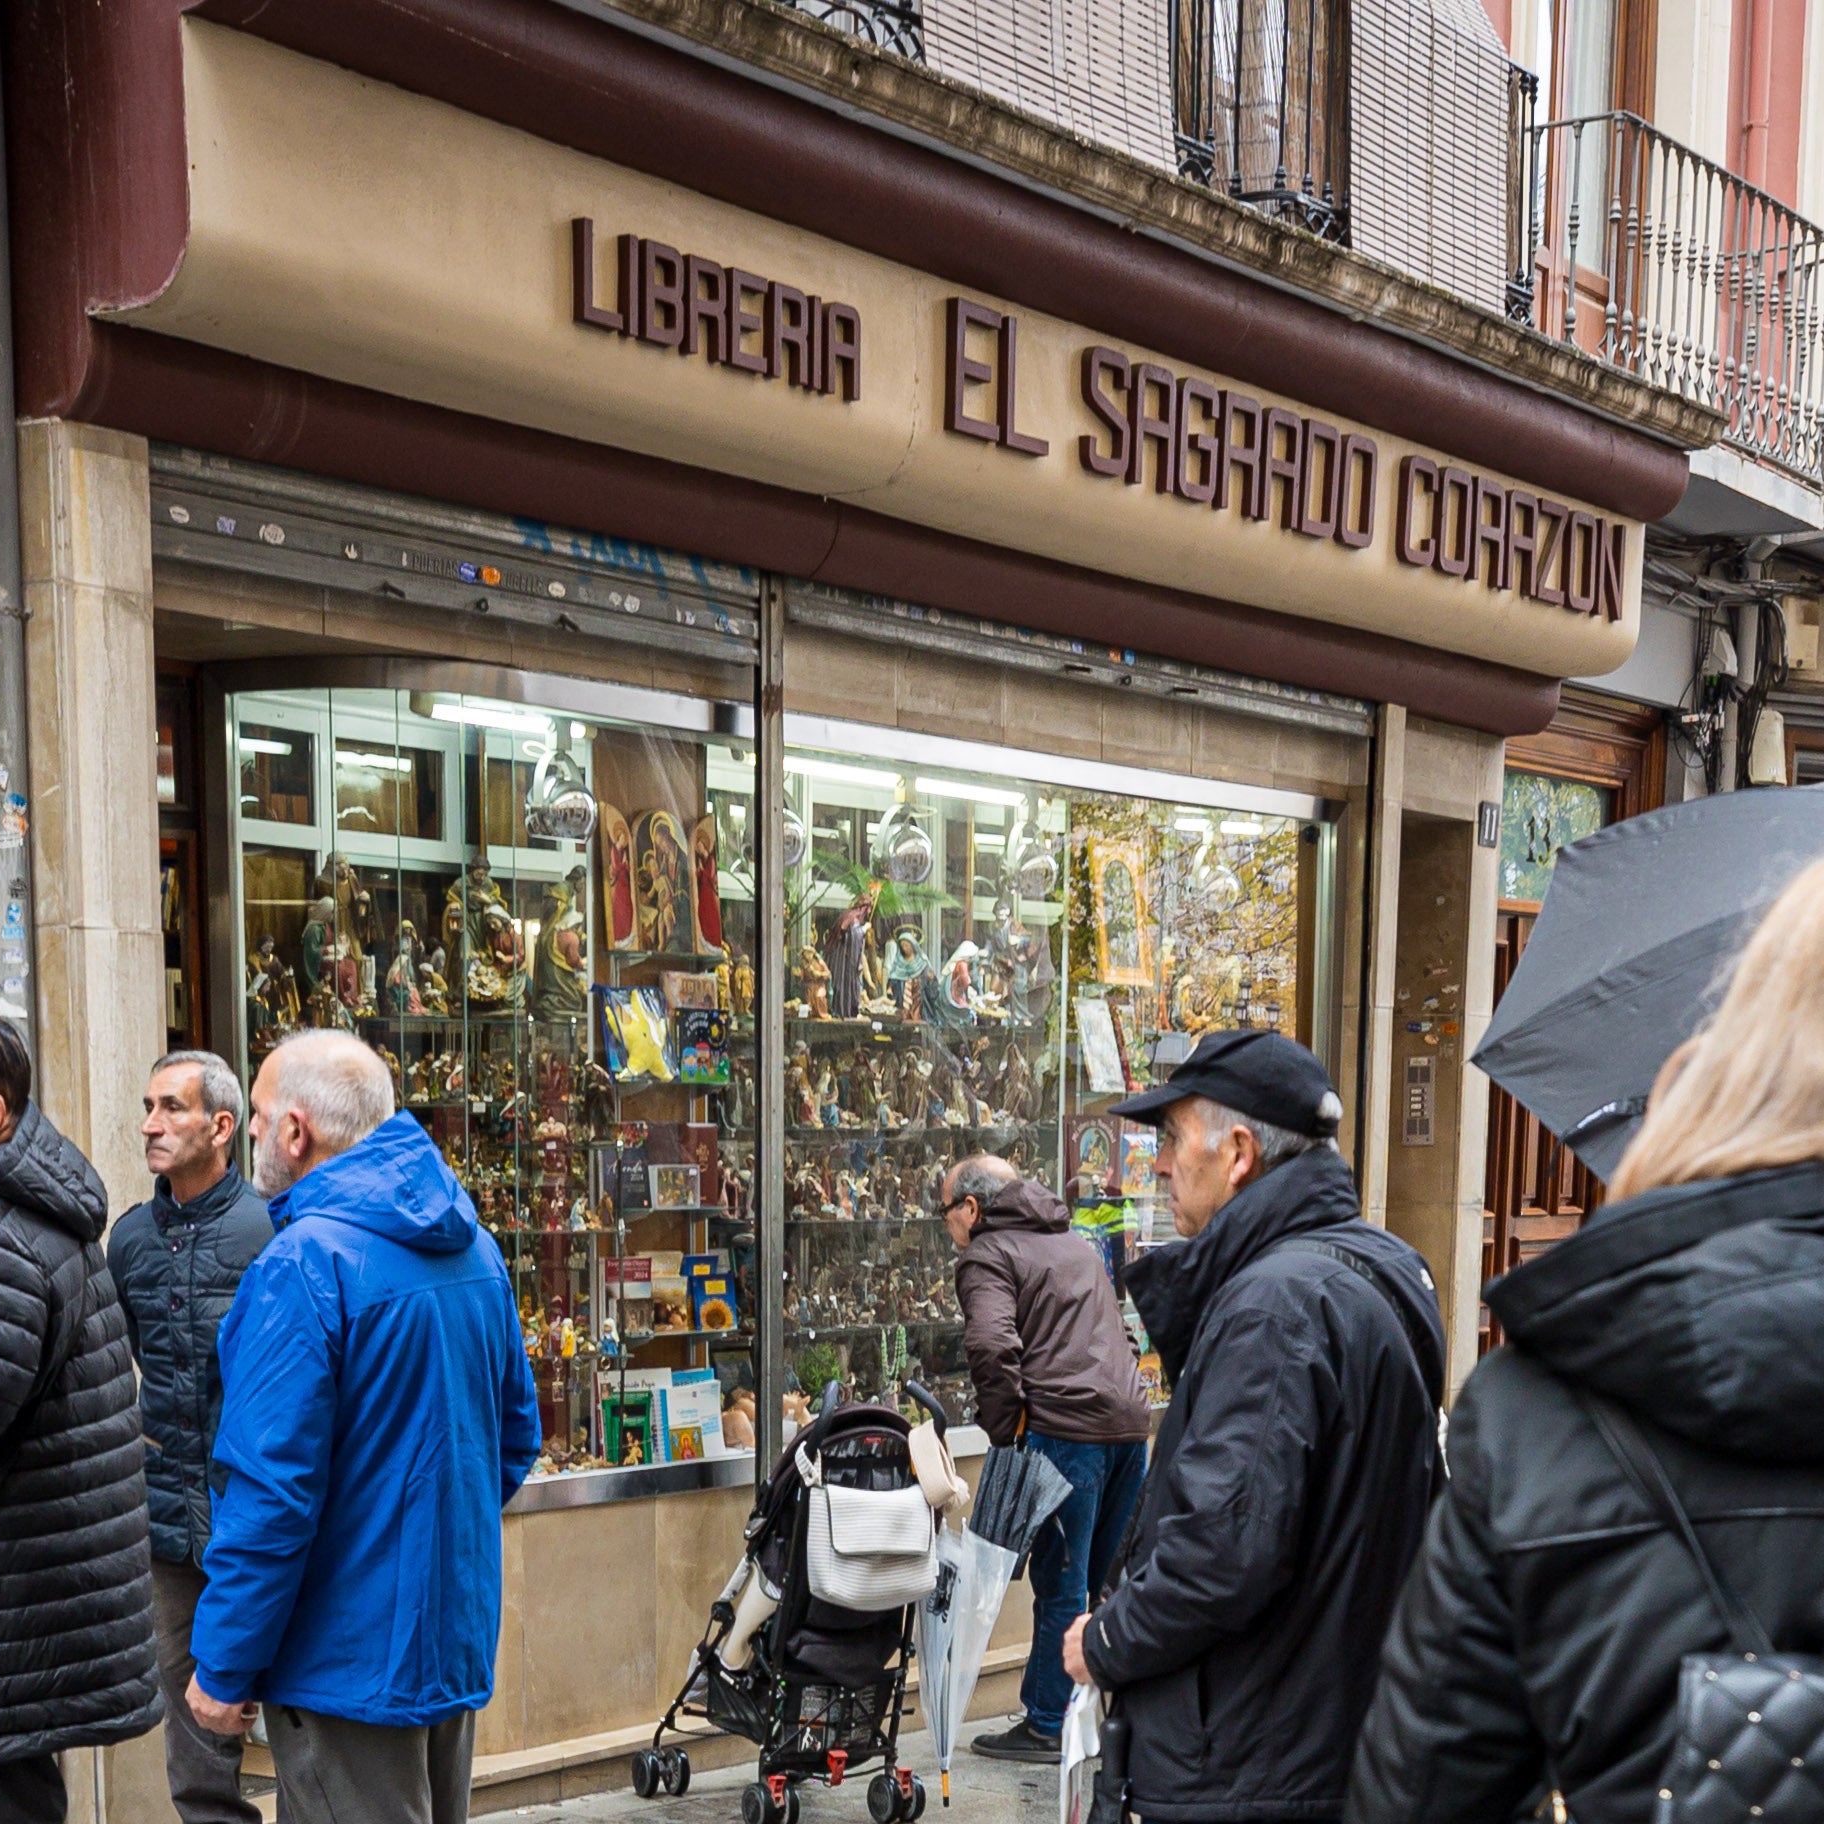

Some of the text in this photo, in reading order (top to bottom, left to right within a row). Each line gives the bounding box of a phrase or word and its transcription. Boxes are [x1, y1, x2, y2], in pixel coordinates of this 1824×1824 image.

[572, 217, 1626, 622] LIBRERIA EL SAGRADO CORAZON
[1484, 808, 1497, 841] 11
